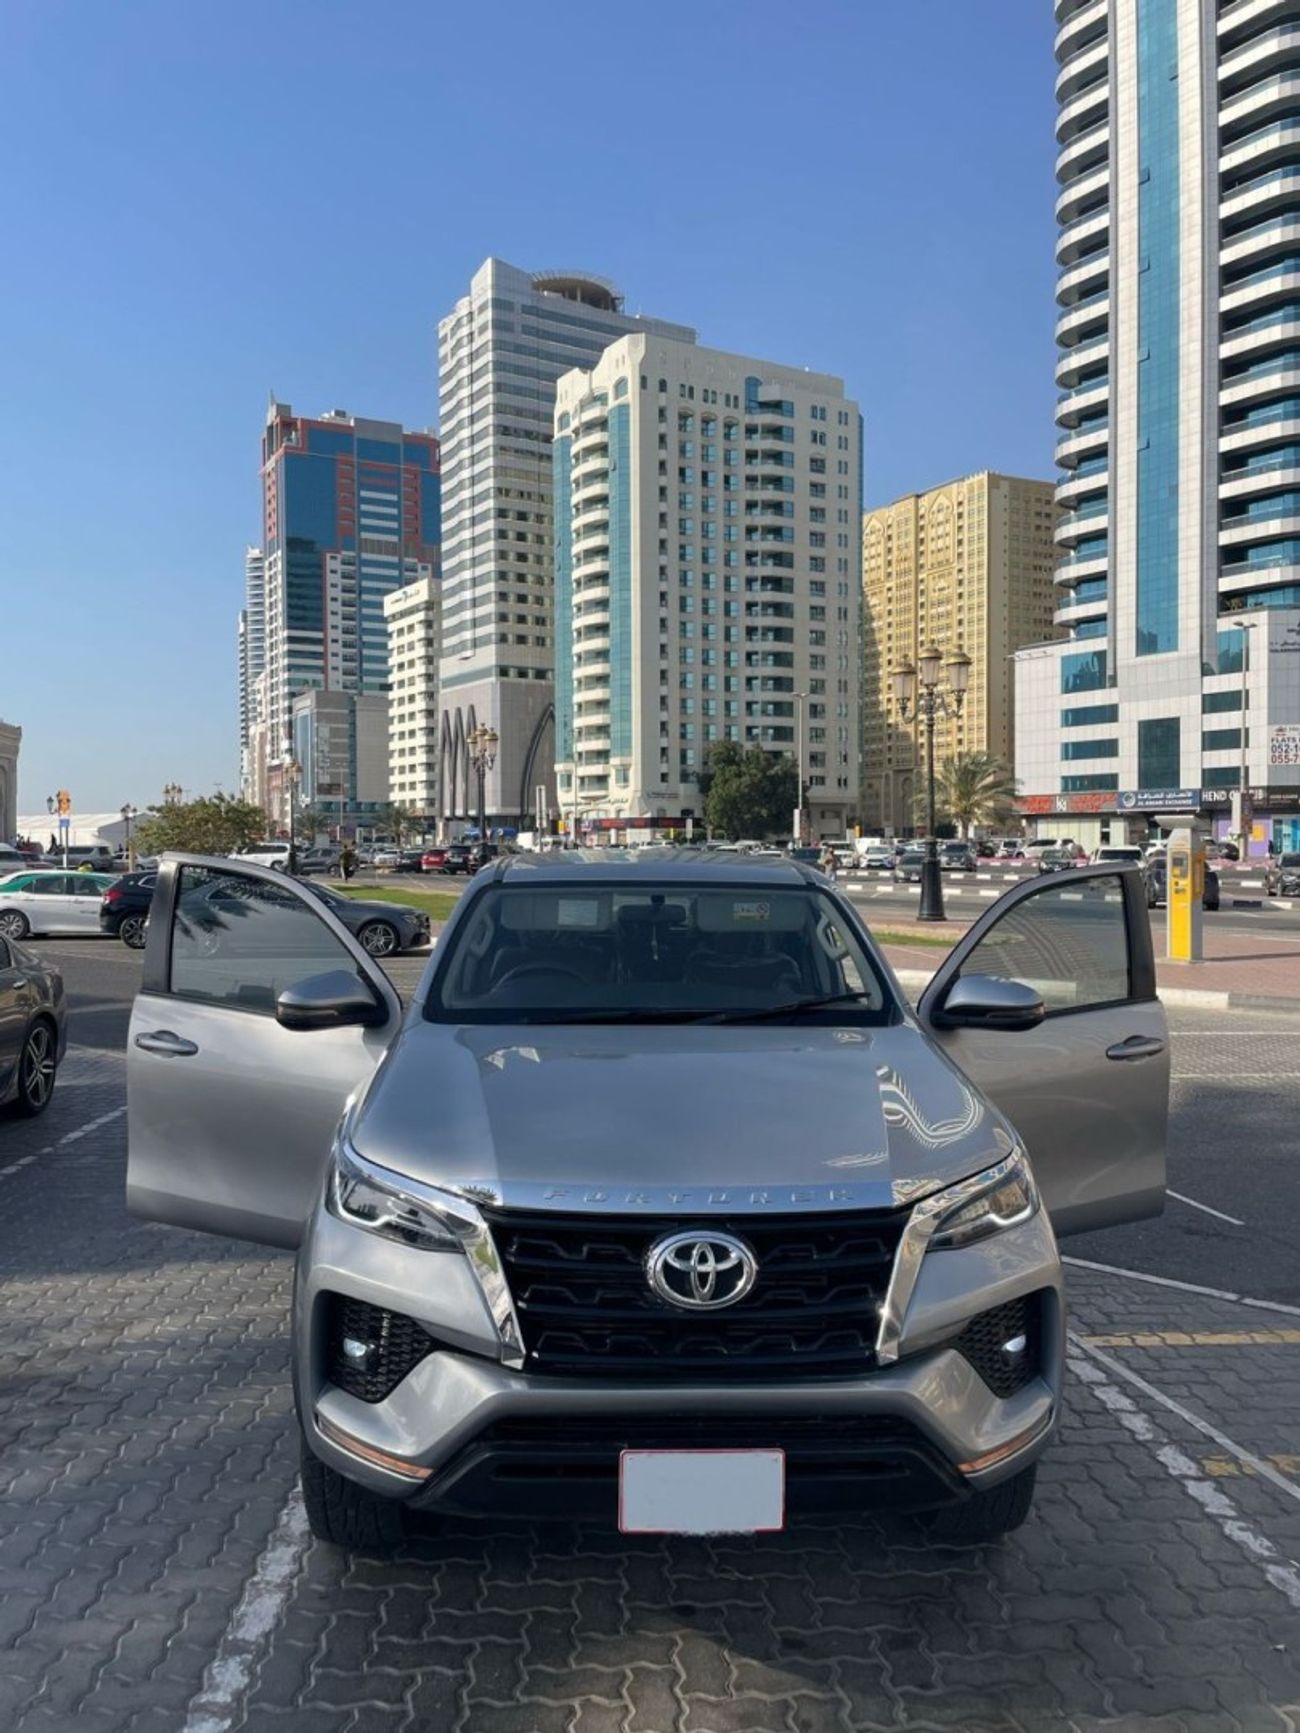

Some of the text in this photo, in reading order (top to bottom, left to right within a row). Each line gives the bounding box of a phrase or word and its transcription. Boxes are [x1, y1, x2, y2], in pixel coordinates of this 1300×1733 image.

[1271, 744, 1300, 753] 052-1
[1202, 791, 1228, 802] HEND
[543, 1188, 854, 1206] FORTUNER
